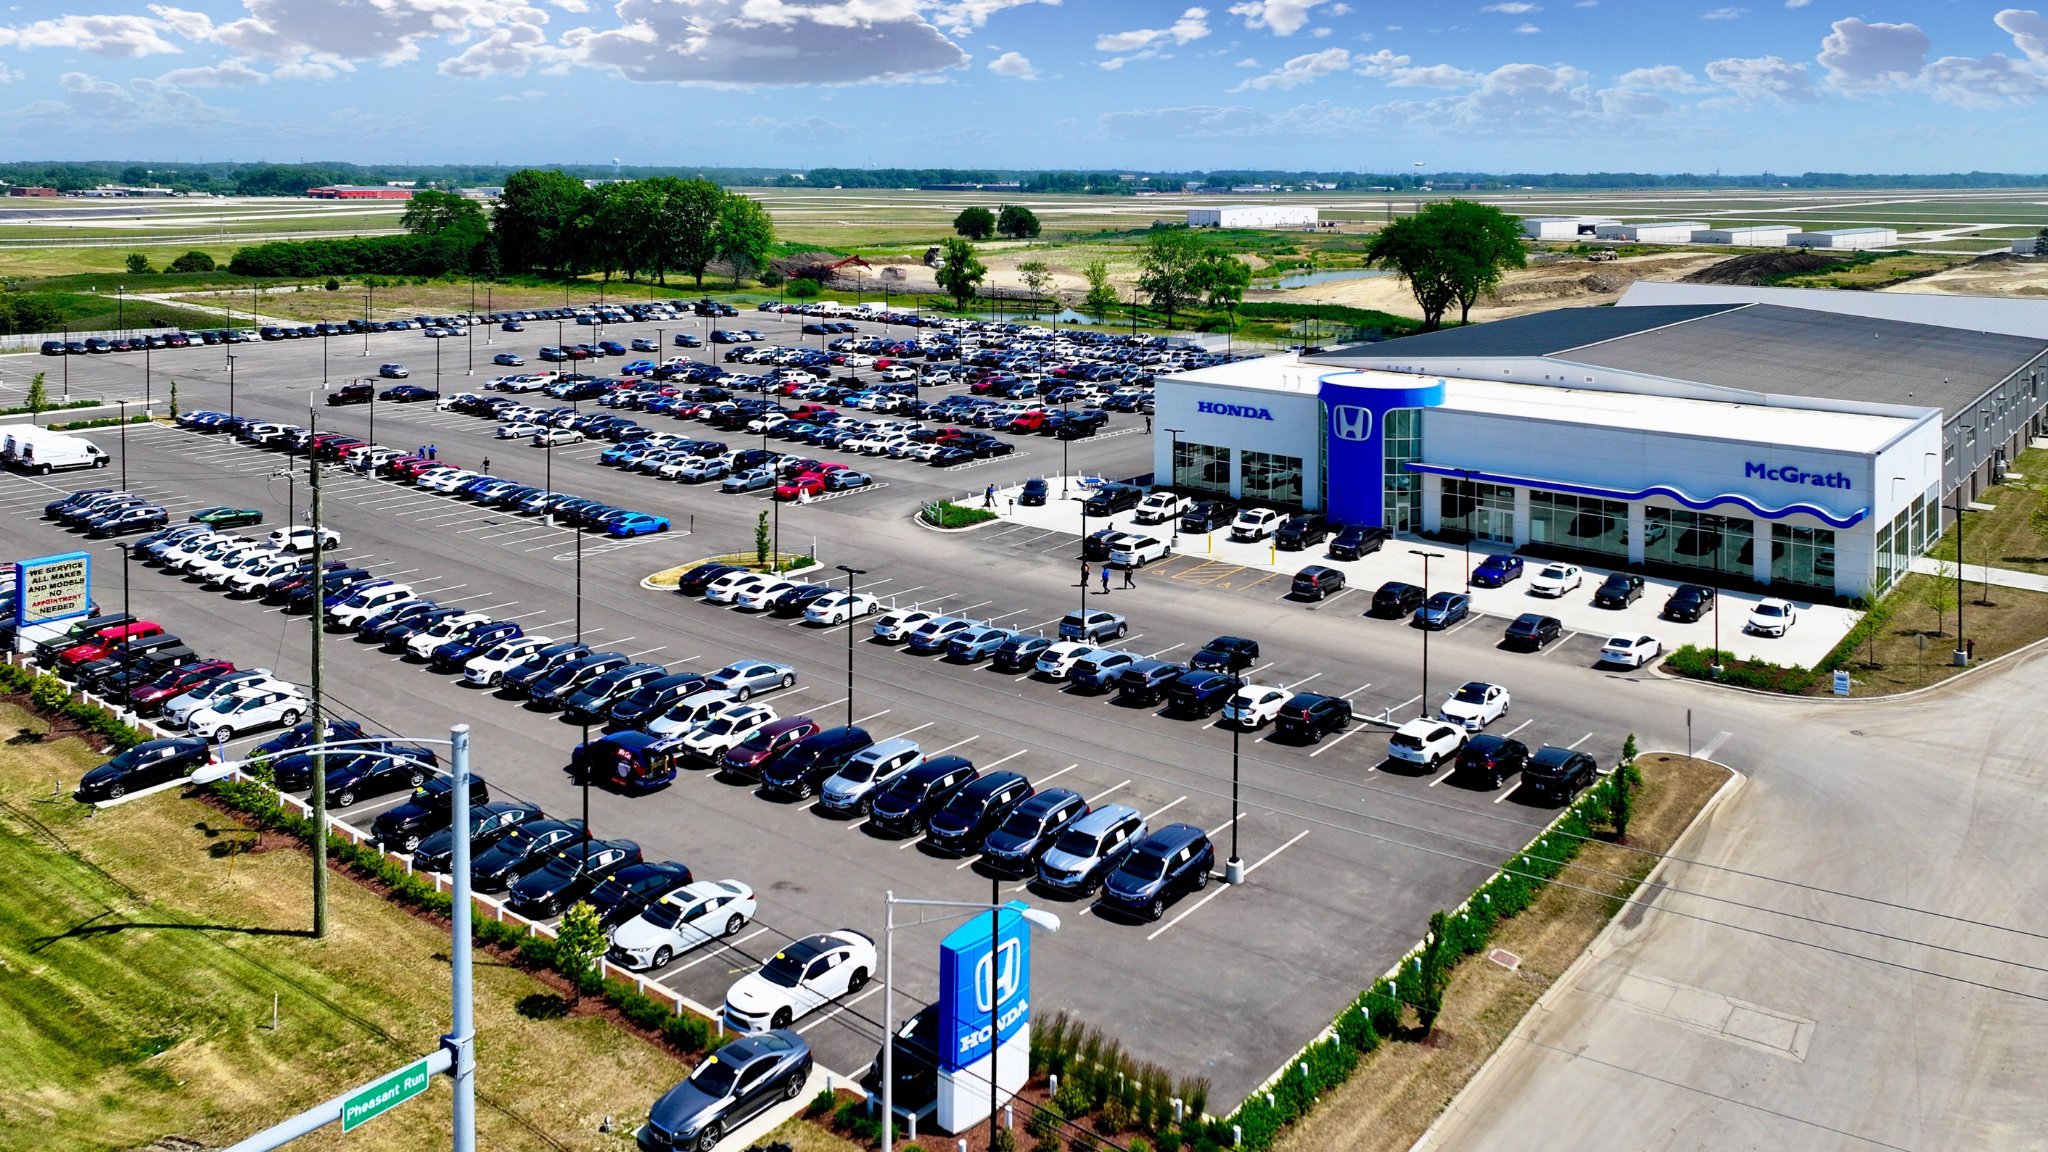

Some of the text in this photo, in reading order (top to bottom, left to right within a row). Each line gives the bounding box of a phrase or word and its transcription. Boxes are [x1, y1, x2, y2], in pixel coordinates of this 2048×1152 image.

[1197, 401, 1274, 421] HONDA
[1745, 462, 1851, 490] McGrath
[46, 562, 82, 573] SERVICE
[32, 571, 81, 585] ALL MAKES
[49, 578, 84, 589] MODELS
[32, 594, 81, 607] APPOINTMENT
[40, 603, 74, 613] NEEDED
[960, 998, 1028, 1053] HONDA
[346, 1073, 425, 1121] Pheasant Run
